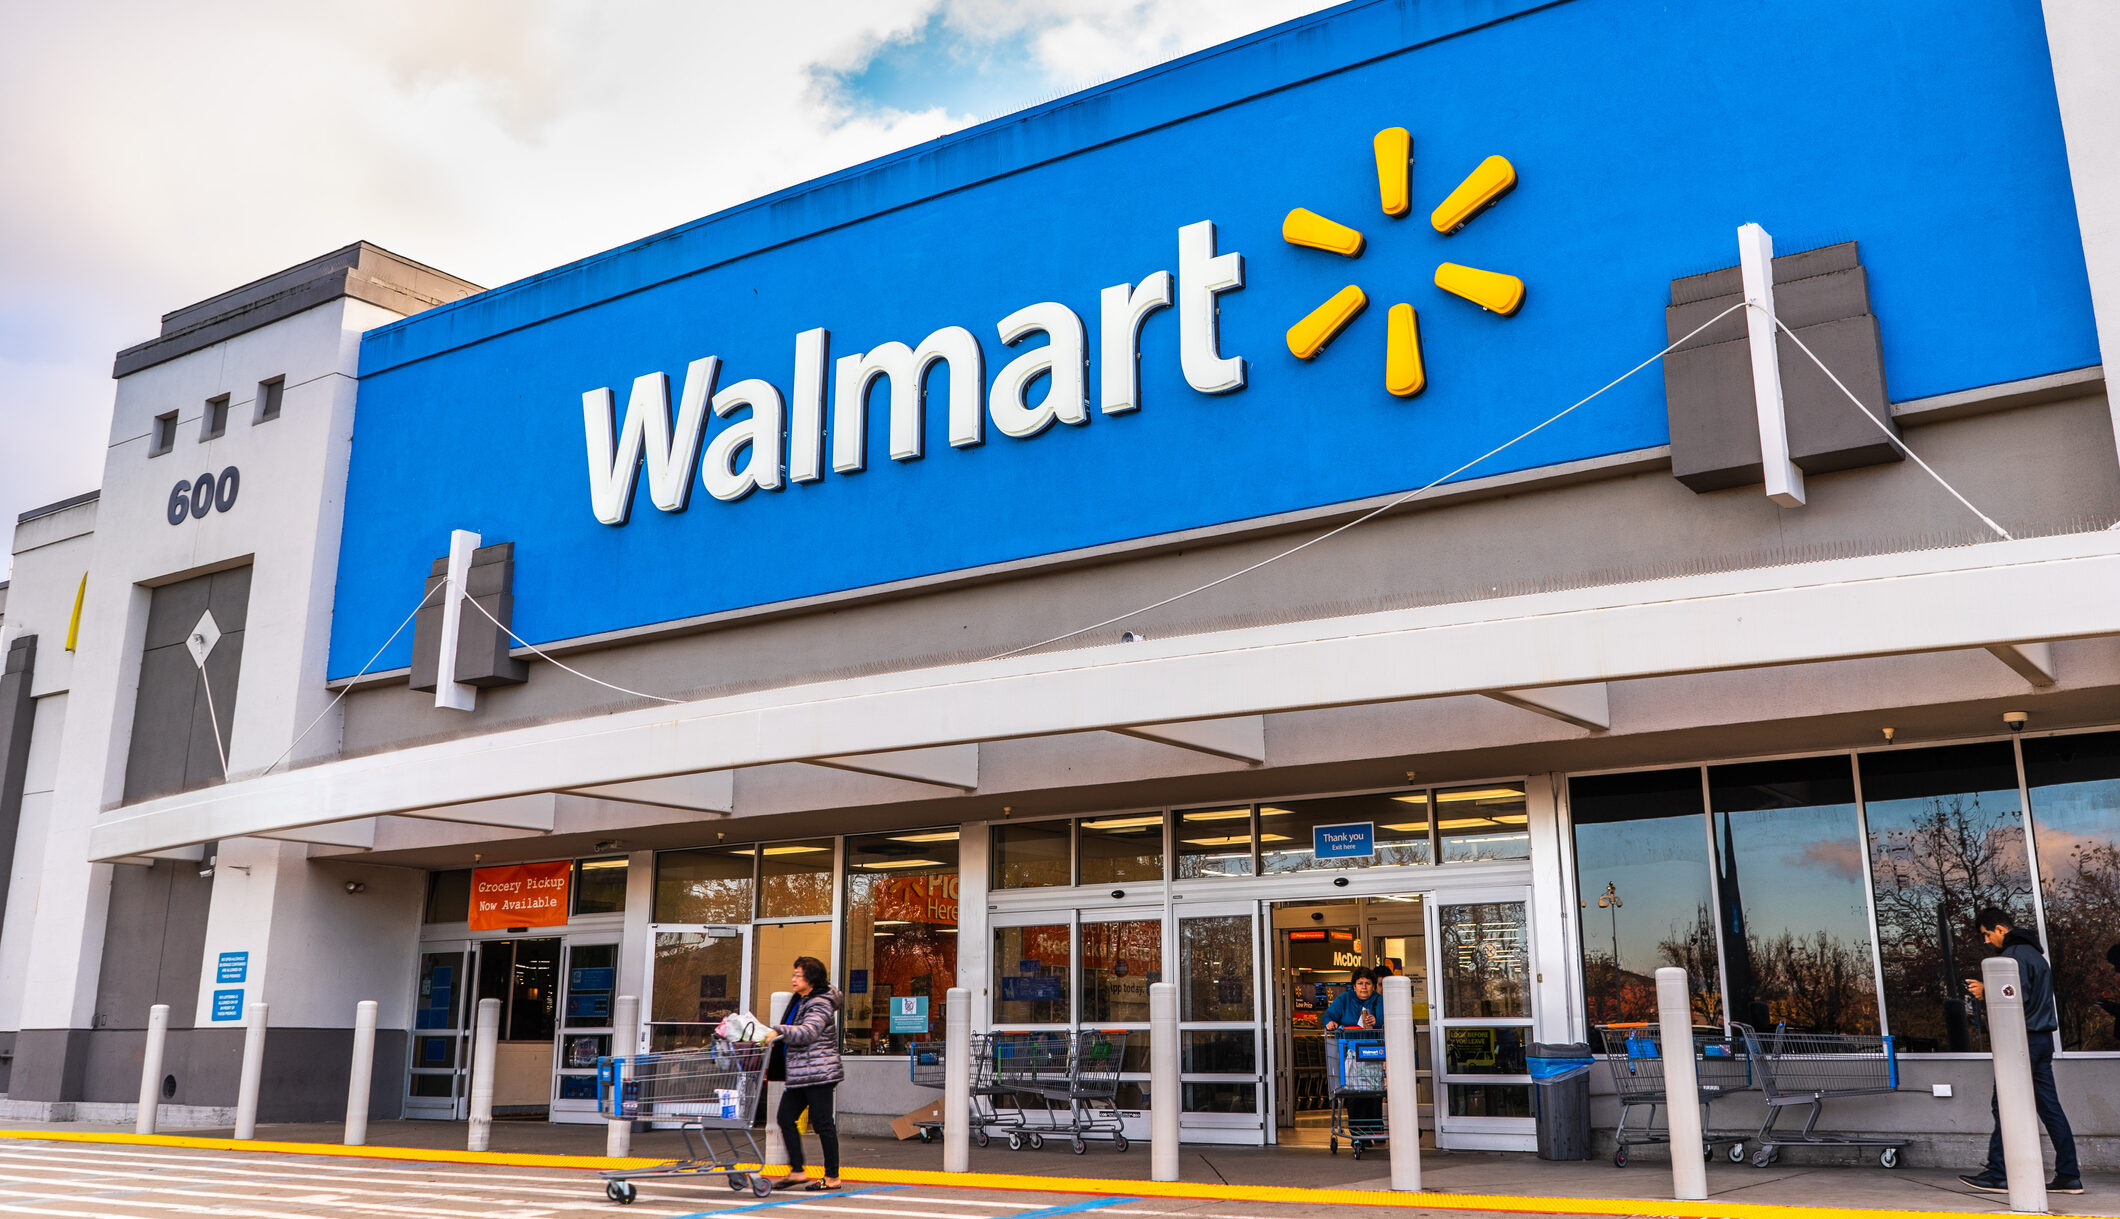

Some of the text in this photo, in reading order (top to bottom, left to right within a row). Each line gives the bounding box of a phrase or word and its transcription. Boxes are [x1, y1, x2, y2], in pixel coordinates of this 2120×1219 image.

[582, 219, 1247, 526] Walmart
[167, 465, 240, 526] 600
[1323, 832, 1364, 843] Thank you
[478, 876, 565, 893] Grocery Pickup
[479, 896, 557, 912] Now Available
[928, 898, 958, 920] Here
[1333, 951, 1381, 967] McDon's
